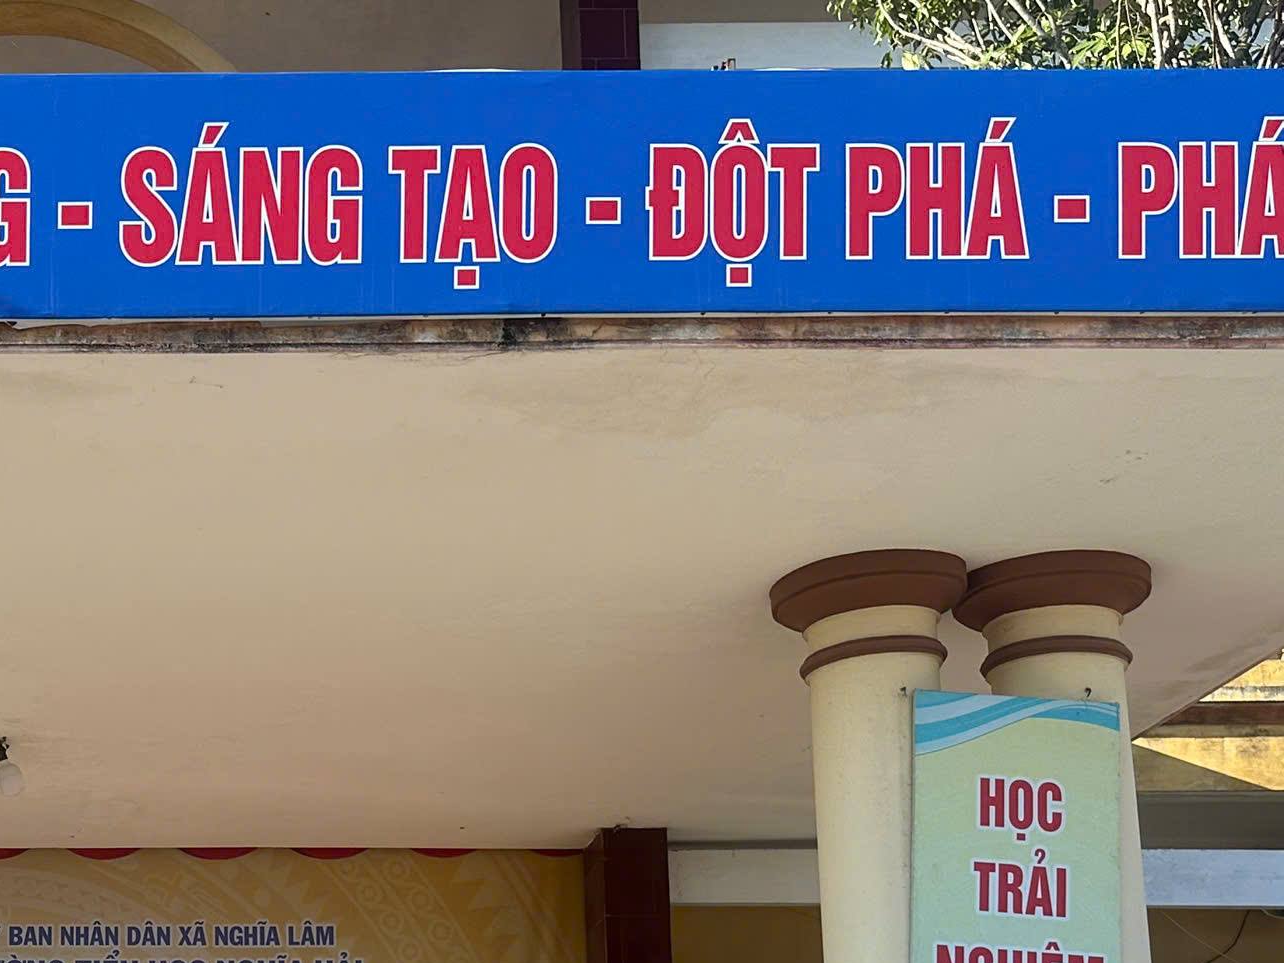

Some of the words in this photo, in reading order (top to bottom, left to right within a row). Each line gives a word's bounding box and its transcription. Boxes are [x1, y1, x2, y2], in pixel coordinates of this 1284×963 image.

[118, 121, 365, 268] SÁNG
[387, 143, 559, 289] TẠO
[644, 118, 821, 288] ĐỘT
[845, 116, 1031, 260] PHÁ
[979, 777, 1063, 841] HỌC
[973, 848, 1067, 918] TRẢI
[8, 926, 53, 946] BAN
[60, 920, 119, 946] NHÂN
[127, 920, 171, 946] DÂN
[178, 920, 207, 946] XÃ
[214, 920, 281, 946] NGHĨA
[288, 920, 335, 946] LÂM
